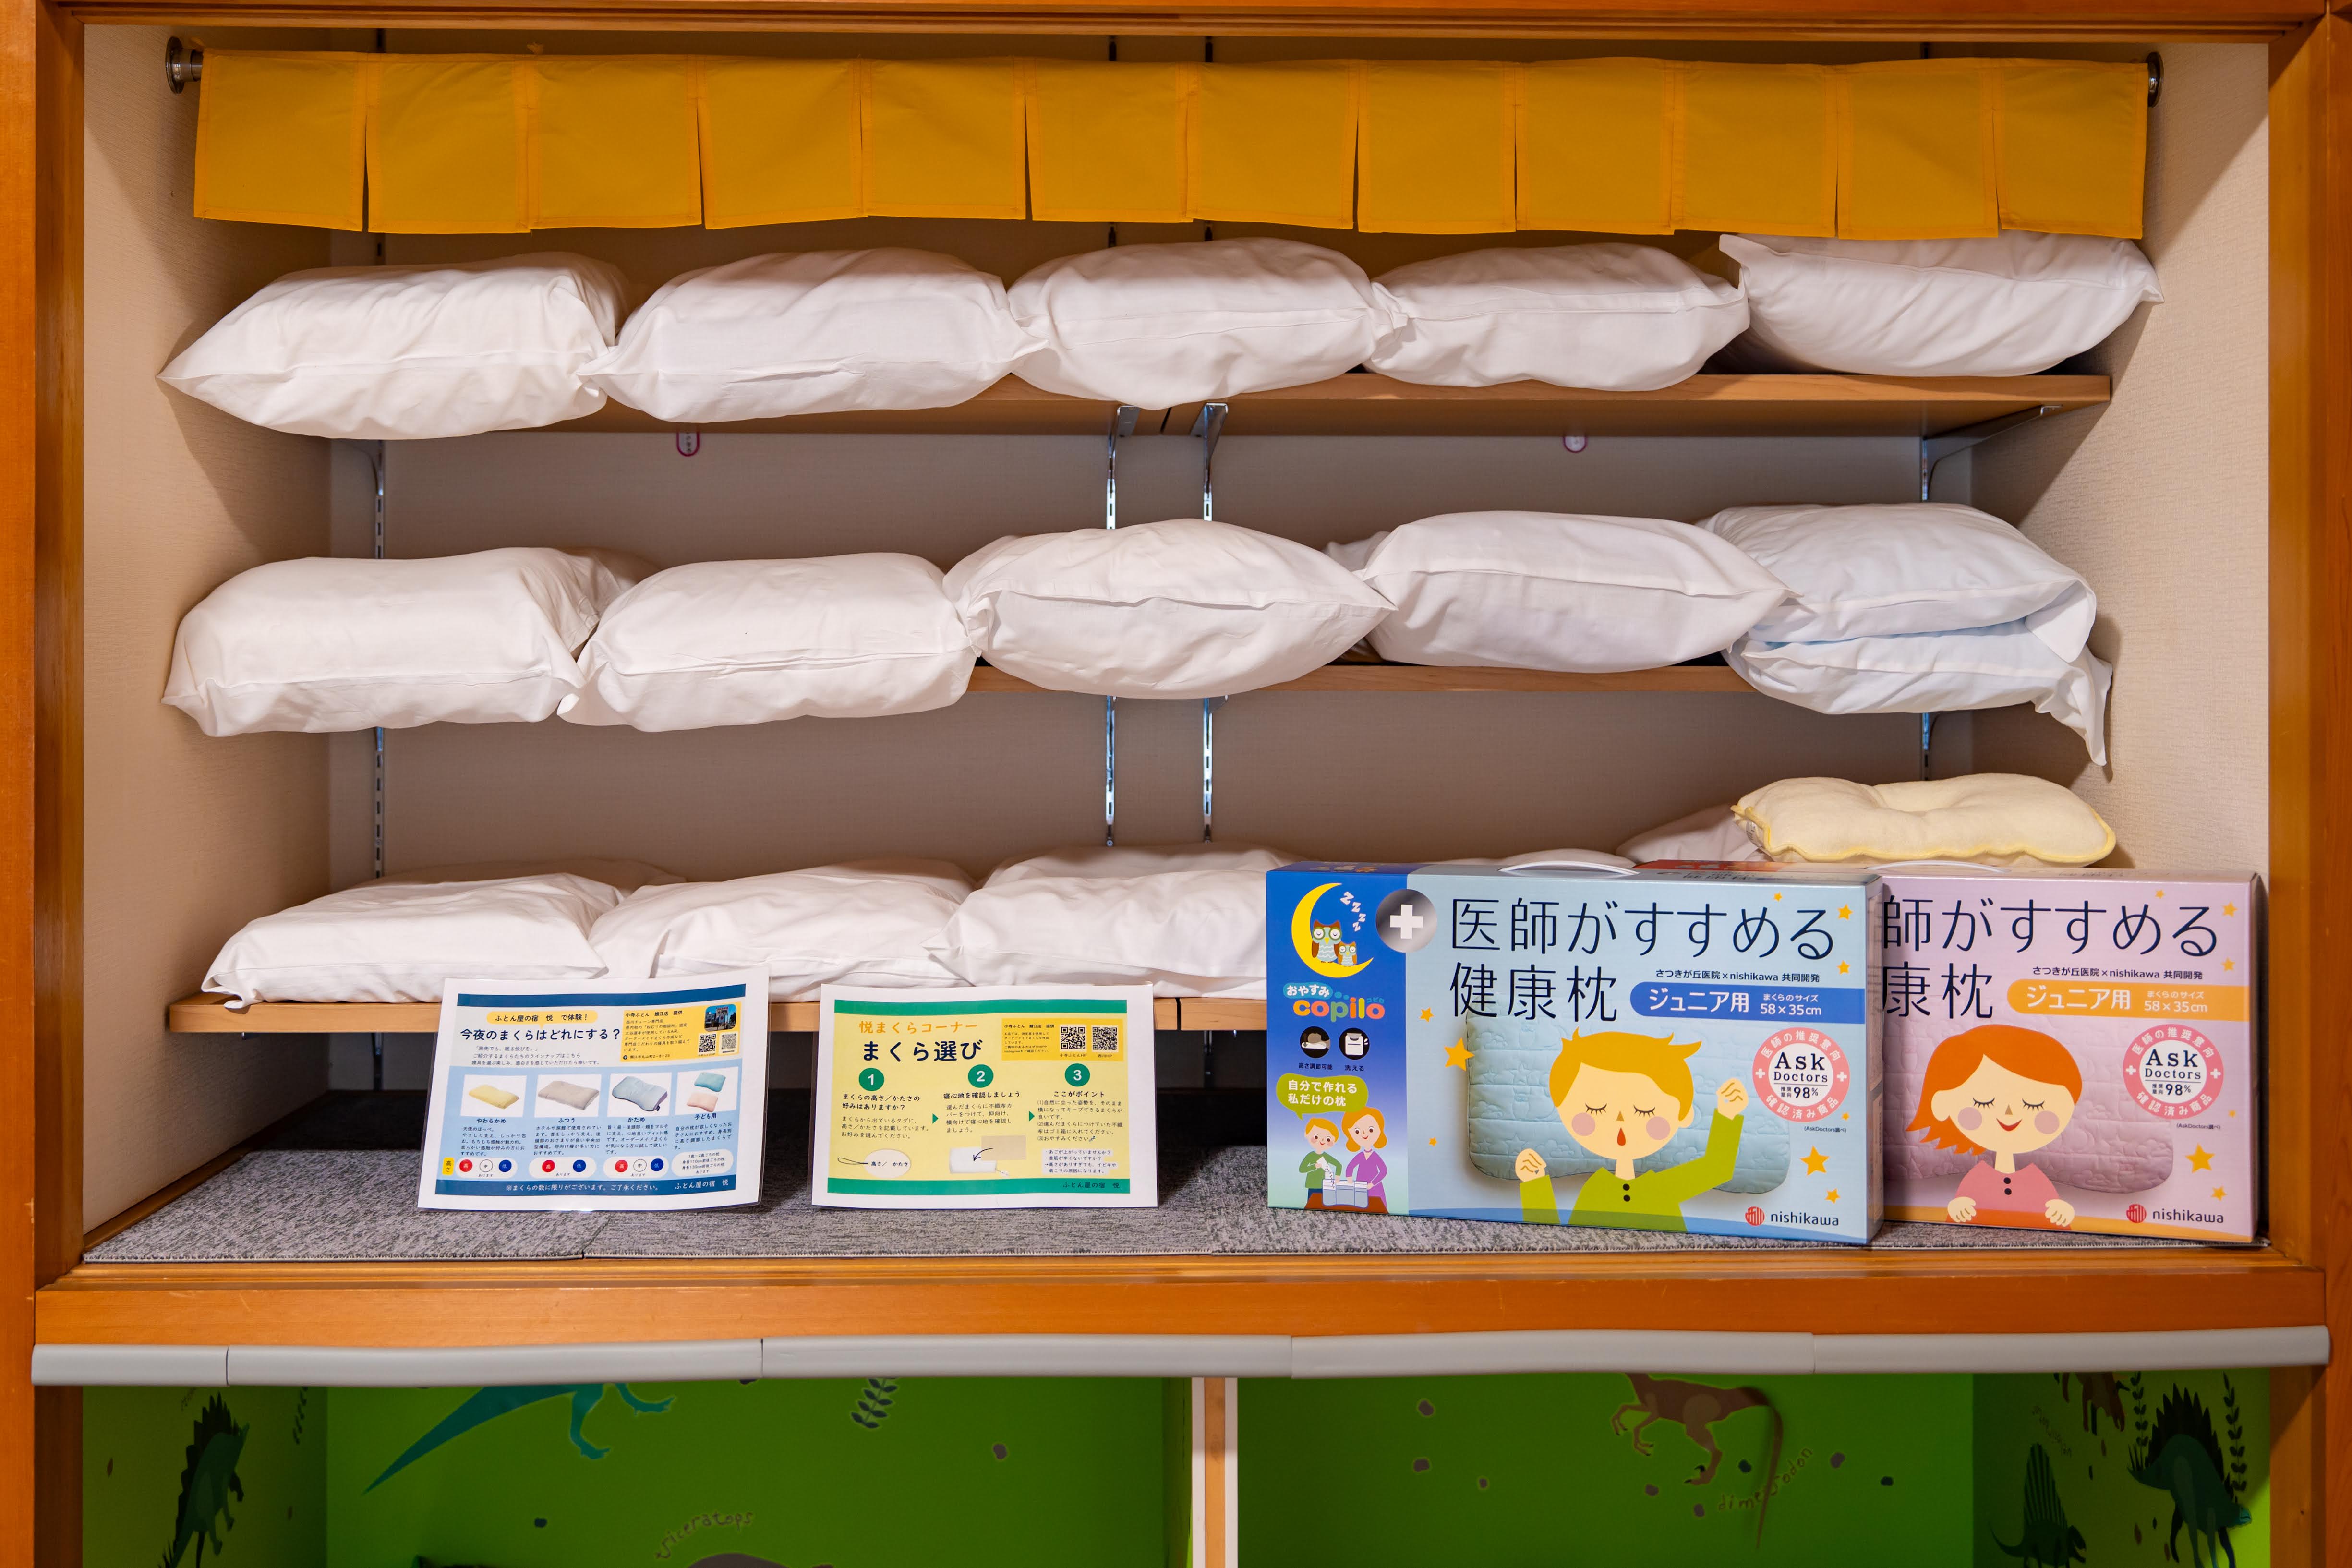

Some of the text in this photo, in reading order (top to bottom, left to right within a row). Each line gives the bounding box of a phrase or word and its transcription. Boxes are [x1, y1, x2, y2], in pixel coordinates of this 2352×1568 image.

[1452, 897, 1833, 960] 医師がすすめる
[1883, 895, 2217, 957] 師がすすめる
[1782, 973, 1820, 982] 共同開発
[2163, 970, 2203, 979] 共同開発
[1287, 984, 1330, 998] おやすみ
[1450, 962, 1617, 1022] 健康枕
[1882, 961, 1993, 1019] 康枕
[2147, 991, 2204, 999] まくらのサイズ
[1649, 988, 1749, 1013] ジュニア用
[1763, 993, 1819, 1002] まくらのサイズ
[2027, 985, 2131, 1010] ジュニア用
[1293, 997, 1385, 1022] copilo
[460, 1028, 620, 1041] 今夜のまくらはどれにする？
[859, 1021, 977, 1034] 悦まくらコーナー
[1761, 1030, 1840, 1061] 医師の推奨意向
[2132, 1027, 2214, 1058] 医師の推奨意向
[864, 1039, 983, 1062] まくら選び
[1775, 1052, 1825, 1070] Ask
[2146, 1049, 2197, 1067] Ask
[868, 1074, 874, 1086] 1
[977, 1071, 985, 1082] 2
[1073, 1069, 1082, 1081] 3
[1774, 1072, 1828, 1082] Doctors
[2145, 1068, 2201, 1079] Doctors
[1288, 1079, 1357, 1094] 自分で作れる
[1794, 1087, 1818, 1098] 98%
[2166, 1084, 2191, 1095] 98%
[943, 1091, 1020, 1099] 寝心地を確認しましょう
[1288, 1093, 1346, 1107] 私だけの枕
[843, 1102, 905, 1110] 好みはありますか？
[1766, 1095, 1838, 1119] 確認済み商品
[2137, 1091, 2212, 1116] 確認済み商品
[675, 1181, 715, 1189] ふとん屋の宿
[1771, 1211, 1838, 1226] nishikawa
[2153, 1208, 2223, 1223] nishikawa
